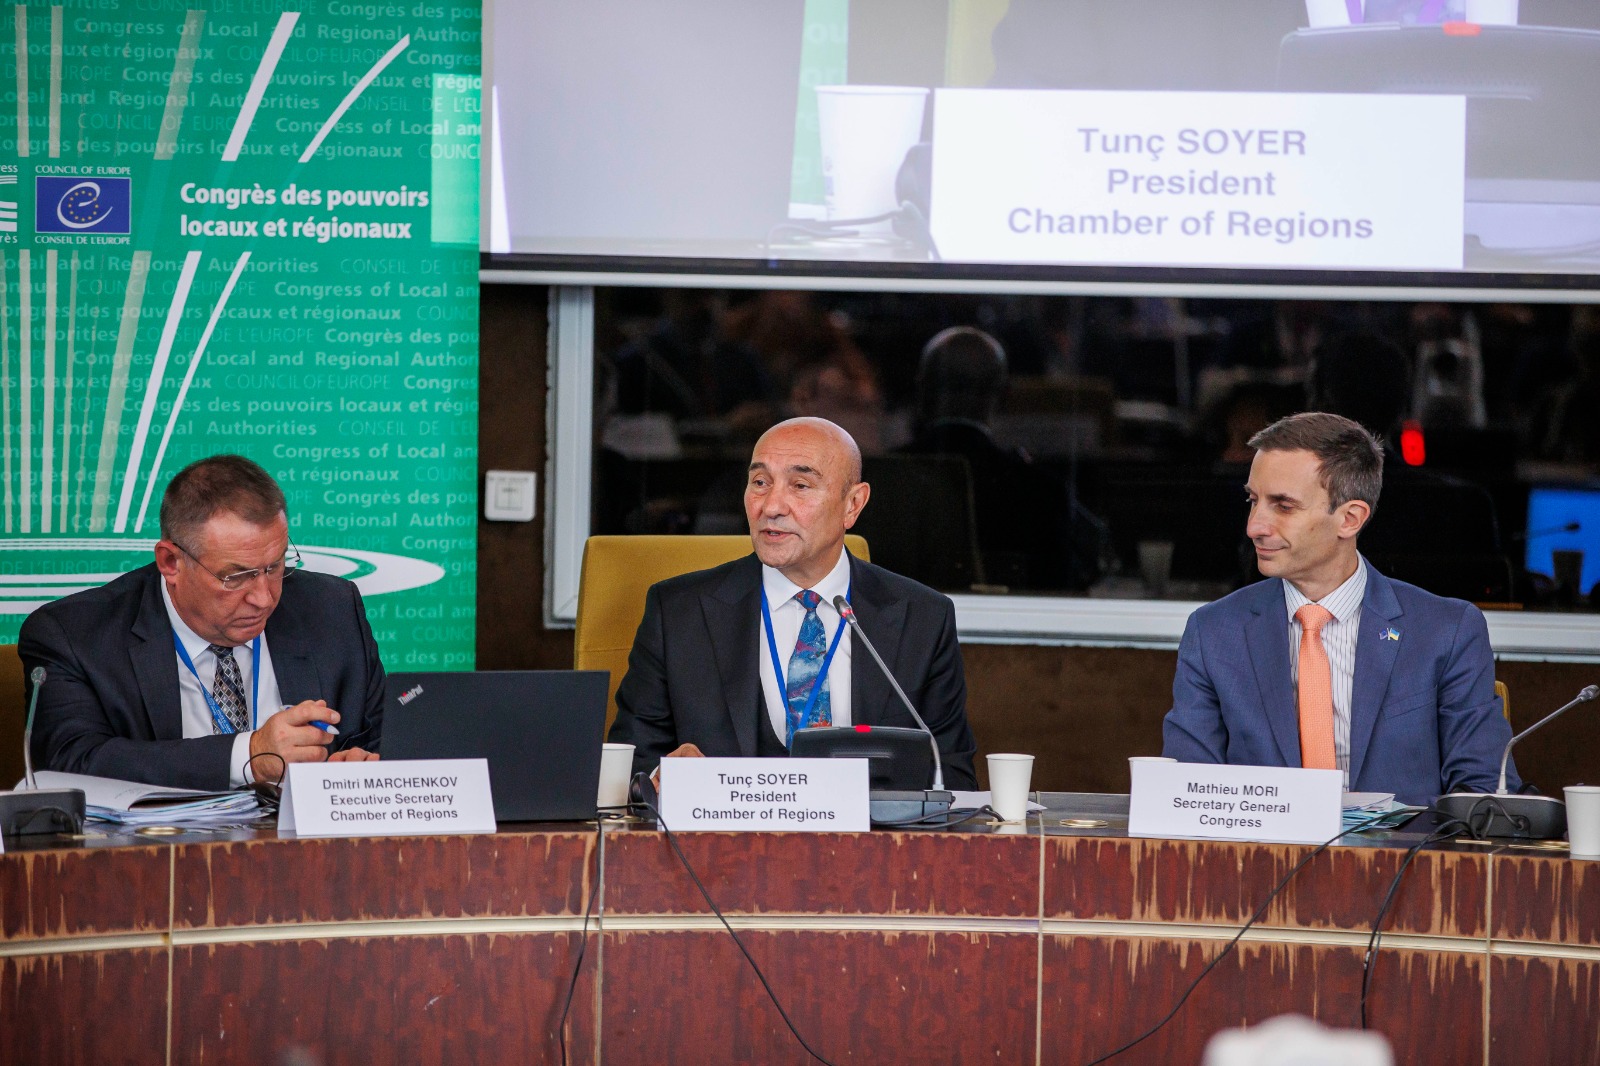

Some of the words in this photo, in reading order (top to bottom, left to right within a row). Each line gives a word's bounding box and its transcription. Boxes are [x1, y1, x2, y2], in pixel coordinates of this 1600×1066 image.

[328, 1, 405, 20] Congrès
[412, 3, 444, 18] des
[74, 17, 164, 37] Congress
[176, 20, 198, 37] of
[208, 21, 258, 38] Local
[318, 24, 402, 43] Regional
[123, 67, 203, 86] Congrès
[211, 70, 243, 85] des
[342, 71, 405, 89] loaux
[412, 75, 431, 89] et
[109, 91, 196, 110] Regional
[209, 92, 320, 111] Autorities
[372, 117, 392, 135] of
[401, 120, 450, 136] Local
[78, 136, 110, 153] des
[280, 142, 299, 157] et
[1078, 126, 1164, 161] Tunç
[1177, 127, 1307, 156] SOYER
[35, 164, 80, 175] COUNCIL
[81, 165, 95, 175] OF
[96, 166, 131, 176] EUROPE
[1107, 167, 1276, 196] President
[180, 182, 276, 210] Congrès
[280, 183, 322, 206] des
[326, 185, 429, 211] pouvoirs
[180, 214, 258, 237] locaux
[262, 217, 288, 237] et
[292, 215, 412, 243] régionaux
[1007, 206, 1168, 236] Chamber
[1180, 208, 1215, 237] of
[1227, 210, 1374, 244] Regions
[34, 234, 74, 245] CONSEIL
[75, 235, 89, 245] DE
[274, 281, 362, 301] Congress
[370, 282, 391, 298] of
[399, 282, 448, 298] Local
[278, 305, 298, 321] et
[303, 305, 402, 324] régionaux
[325, 328, 403, 347] Congrès
[409, 329, 442, 344] des
[206, 351, 256, 367] Local
[267, 351, 304, 367] and
[315, 351, 400, 370] Regional
[208, 398, 241, 412] des
[247, 398, 333, 416] pouvoirs
[340, 398, 402, 413] locaux
[408, 399, 428, 413] et
[207, 420, 317, 436] Authorities
[273, 443, 361, 462] Congress
[368, 443, 389, 459] of
[397, 442, 446, 459] Local
[276, 467, 296, 482] et
[302, 465, 400, 485] régionaux
[323, 490, 401, 508] Congrès
[408, 489, 440, 504] des
[313, 513, 398, 532] Regional
[395, 603, 444, 619] Local
[405, 649, 437, 665] des
[322, 778, 360, 790] Dmitri
[363, 776, 458, 790] MARCHENKOV
[717, 773, 752, 788] Tunç
[757, 772, 808, 785] SOYER
[1186, 781, 1238, 796] Mathieu
[1242, 784, 1278, 797] MORI
[330, 793, 391, 806] Executive
[394, 792, 454, 806] Secretary
[730, 789, 797, 802] President
[1173, 796, 1236, 813] Secretary
[1239, 799, 1290, 813] General
[330, 809, 387, 821] Chamber
[390, 809, 403, 820] of
[406, 808, 458, 822] Regions
[692, 807, 755, 820] Chamber
[760, 807, 774, 820] of
[777, 807, 835, 823] Regions
[1199, 813, 1262, 829] Congress
